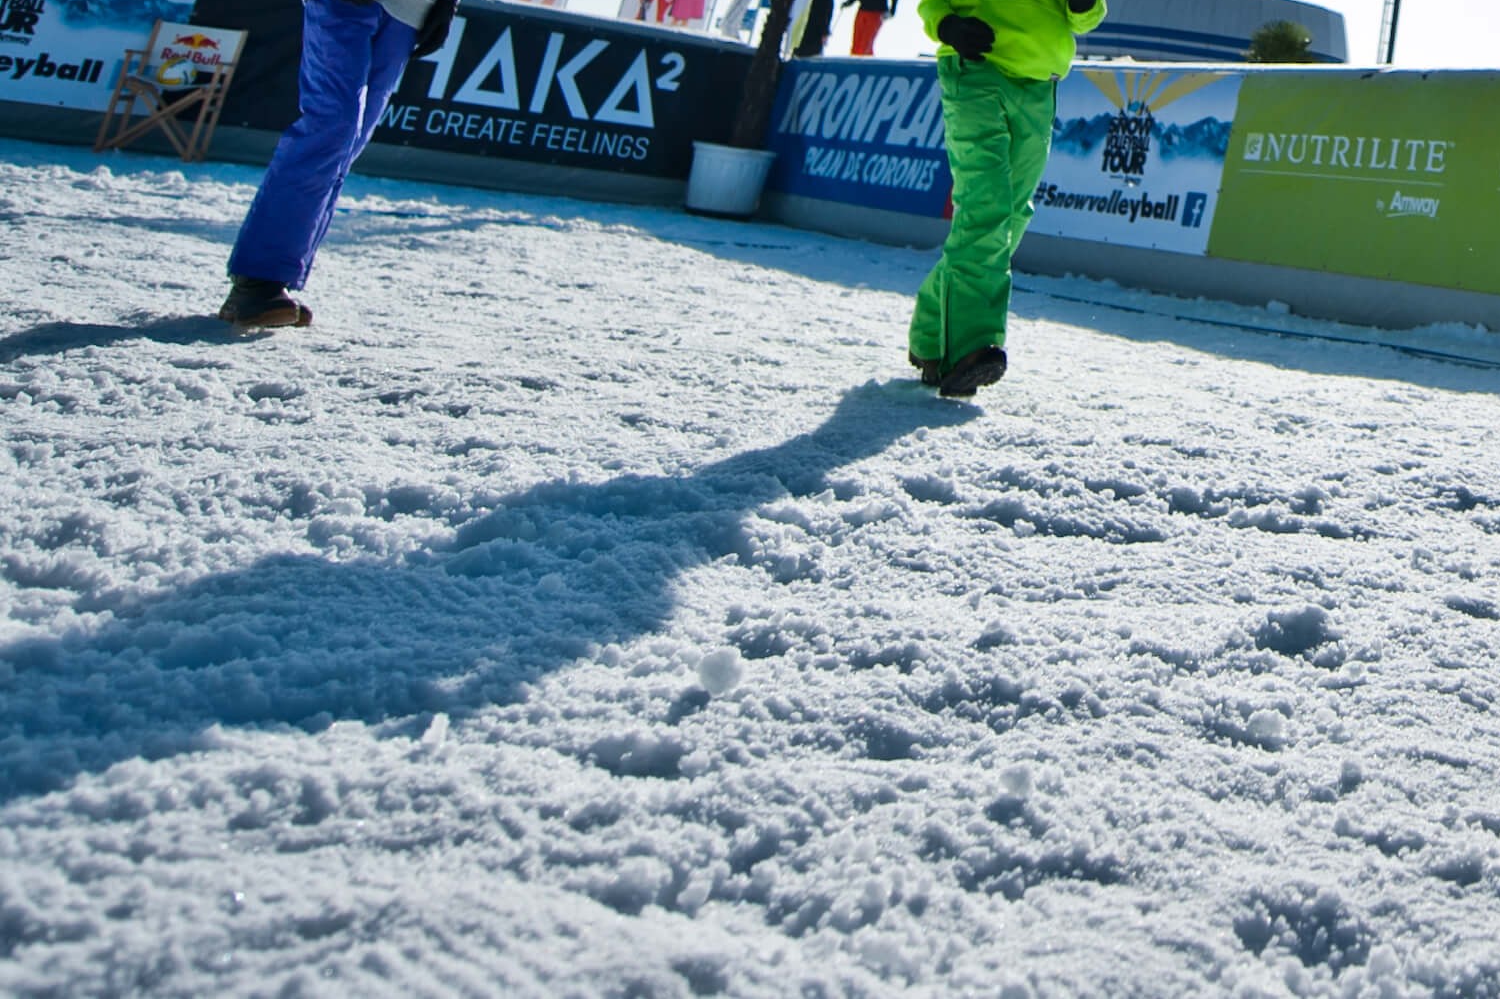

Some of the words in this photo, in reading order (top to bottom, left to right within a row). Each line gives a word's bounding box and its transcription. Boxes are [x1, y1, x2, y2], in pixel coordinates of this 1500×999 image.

[425, 109, 524, 145] CREATE
[530, 123, 650, 161] FEELINGS
[1264, 132, 1447, 173] NUTRILITE
[803, 147, 847, 179] PLAN
[840, 152, 866, 183] DE
[863, 153, 941, 192] CORONES
[1102, 150, 1147, 175] TOUR
[1390, 190, 1440, 217] Amway
